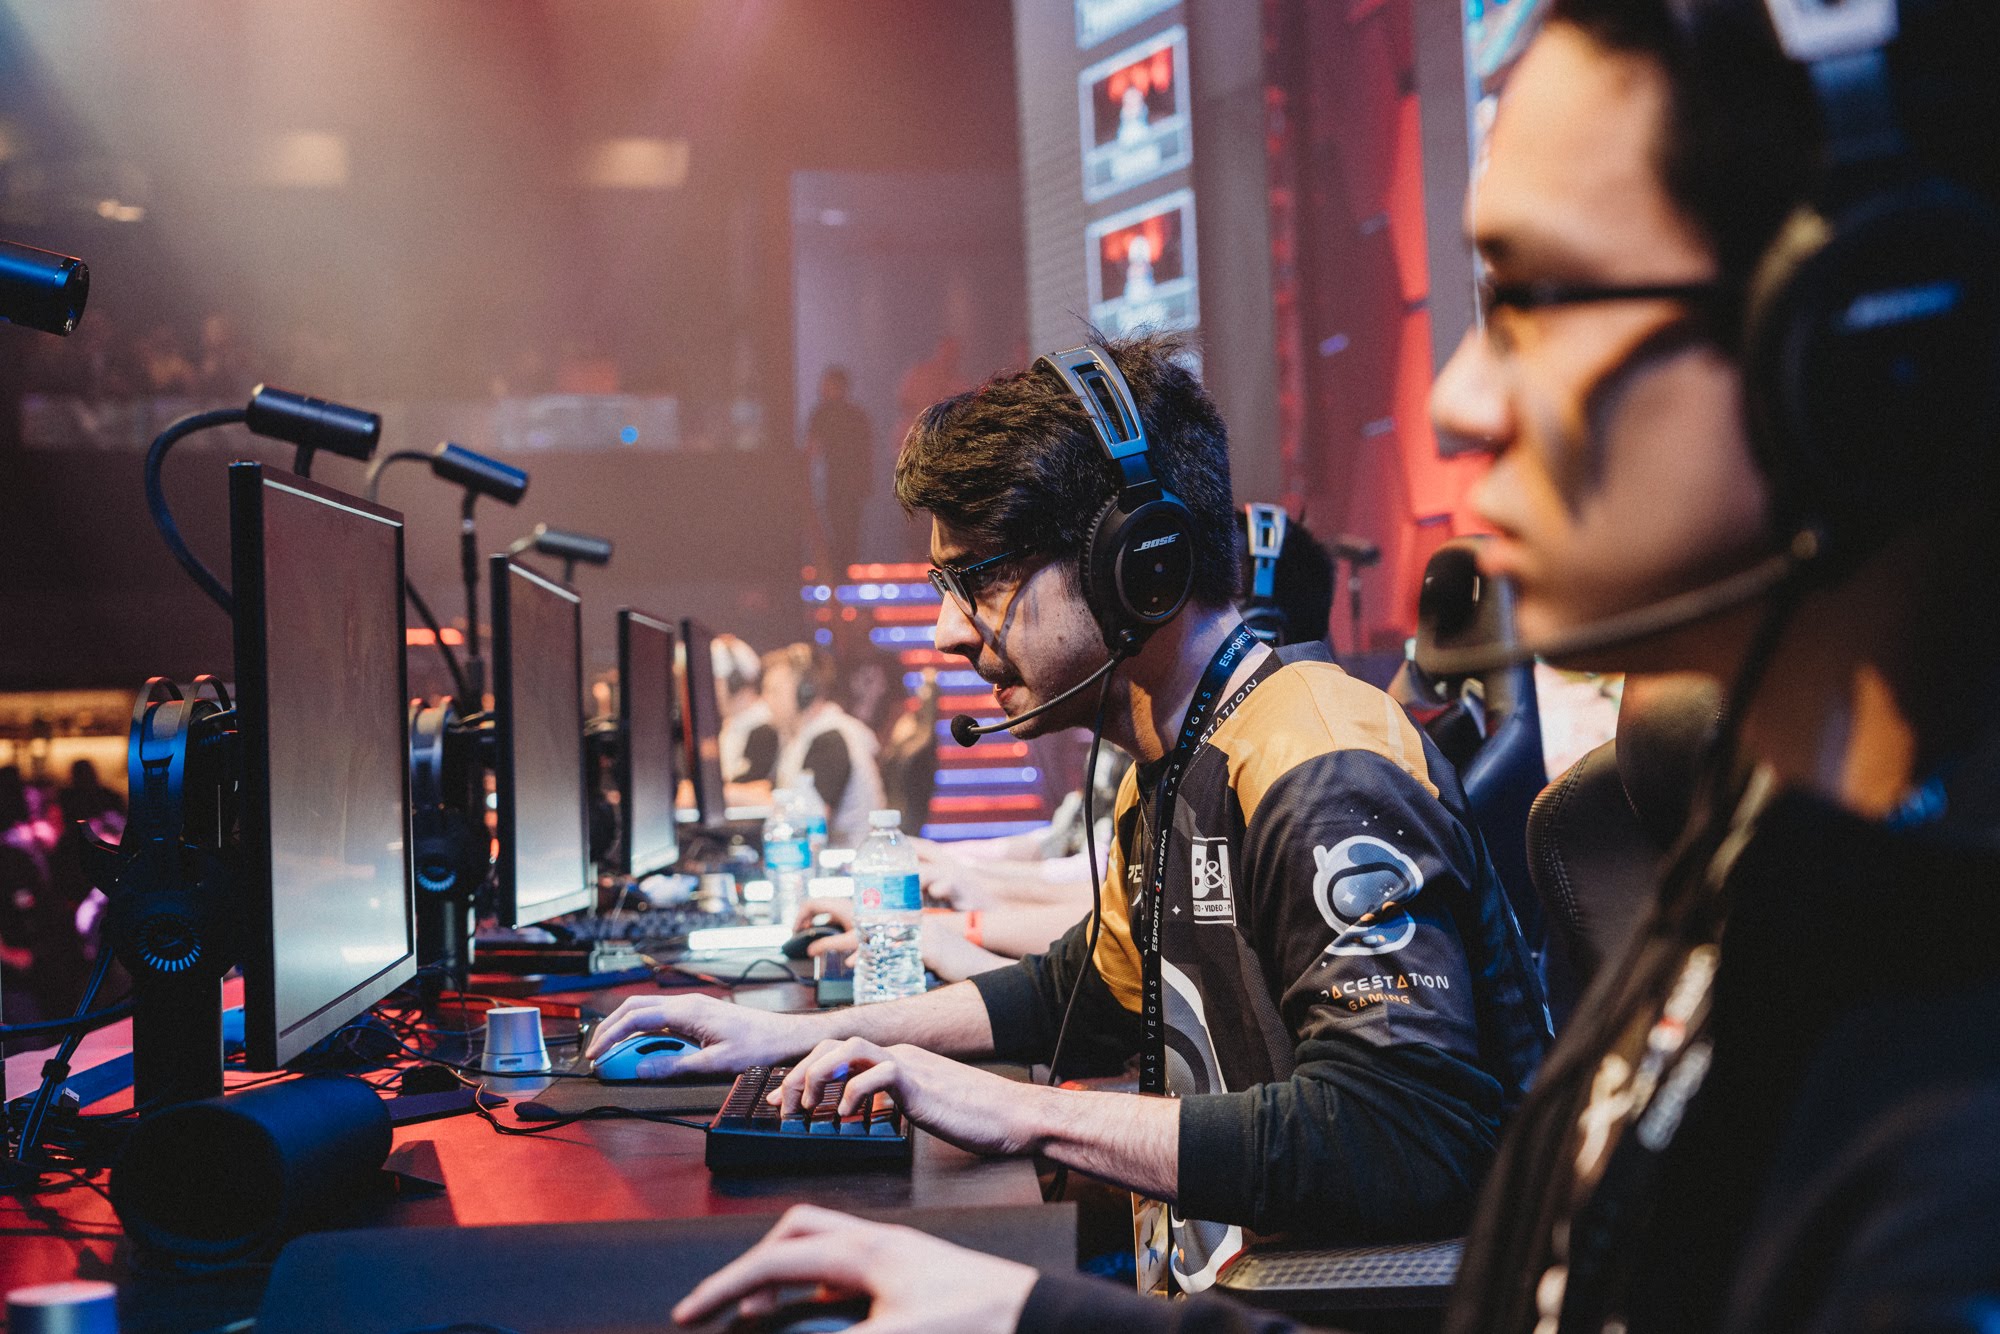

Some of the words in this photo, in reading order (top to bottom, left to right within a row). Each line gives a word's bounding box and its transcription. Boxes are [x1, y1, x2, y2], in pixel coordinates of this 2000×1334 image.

[1133, 532, 1180, 552] BOSE
[1180, 691, 1211, 749] VEGAS
[1218, 631, 1251, 668] ESPORTS
[1157, 828, 1168, 877] ARENA
[1151, 894, 1161, 952] ESPORTS
[1204, 903, 1224, 913] VIDEO
[1147, 979, 1157, 1040] VEGAS
[1347, 992, 1411, 1012] GAMING
[1146, 1054, 1155, 1086] LAS
